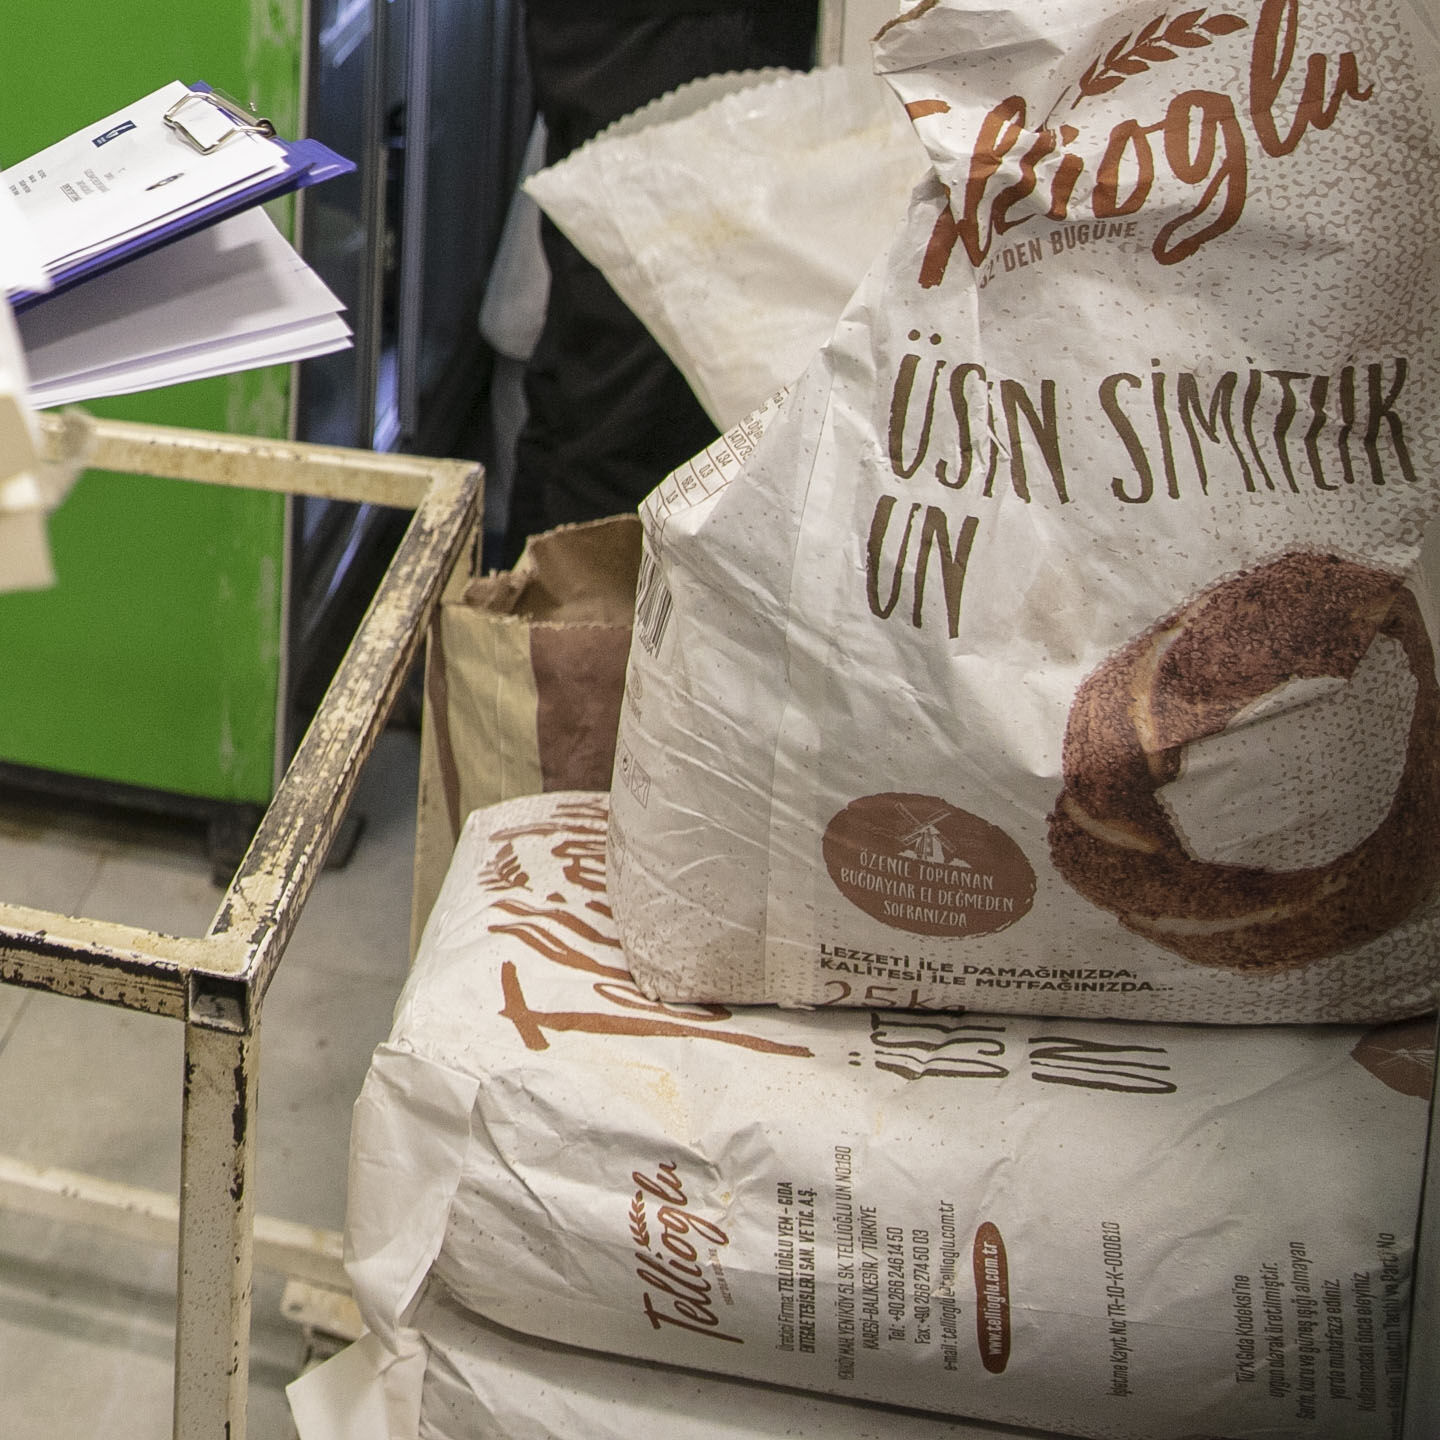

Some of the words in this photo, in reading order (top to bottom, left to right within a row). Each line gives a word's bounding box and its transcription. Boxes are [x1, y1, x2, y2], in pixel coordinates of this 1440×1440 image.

[1050, 220, 1138, 256] BUGÜNE
[1101, 356, 1418, 505] SİMİTLİK
[867, 495, 980, 640] UN
[840, 866, 916, 900] BUĞDAYLAR
[920, 885, 933, 903] EL
[938, 887, 1014, 913] DEĞMEDEN
[920, 862, 994, 891] TOPLANAN
[883, 900, 968, 928] SOFRANIZDA
[819, 956, 923, 983] KALİTESİ
[932, 970, 966, 987] İLE
[820, 943, 910, 969] LEZZETİ
[920, 956, 954, 974] İLE
[963, 962, 1138, 980] DAMAĞINIZDA,
[1028, 1037, 1177, 1094] UN
[777, 1182, 792, 1205] GIDA
[798, 1188, 817, 1207] A.Ş.
[836, 1186, 852, 1200] UN
[779, 1218, 793, 1237] YEM
[796, 1210, 813, 1227] TİC.
[833, 1204, 854, 1259] TELLİOĞLU
[859, 1206, 878, 1249] TÜRKİYE
[799, 1228, 814, 1242] VE
[886, 1227, 903, 1241] 50
[912, 1229, 928, 1244] 03
[632, 1161, 744, 1344] Tellioglu
[799, 1247, 814, 1271] SAN.
[887, 1243, 903, 1255] 14
[913, 1247, 928, 1260] 50
[774, 1241, 793, 1291] TELLİOĞLU
[887, 1258, 904, 1278] 246
[913, 1264, 929, 1282] 274
[1101, 1221, 1126, 1317] TR-10-K-000610
[1289, 1241, 1314, 1293] almayan
[888, 1279, 904, 1300] 266
[913, 1284, 929, 1303] 266
[981, 1241, 1006, 1355] www.tellioglu.com.tr
[835, 1295, 855, 1335] YENİKÖY
[859, 1261, 879, 1350] KARESİ-BALIKESİR
[888, 1303, 904, 1321] +90
[1108, 1337, 1132, 1363] Kayıt
[1235, 1338, 1255, 1360] Gıda
[1295, 1320, 1320, 1353] güneş
